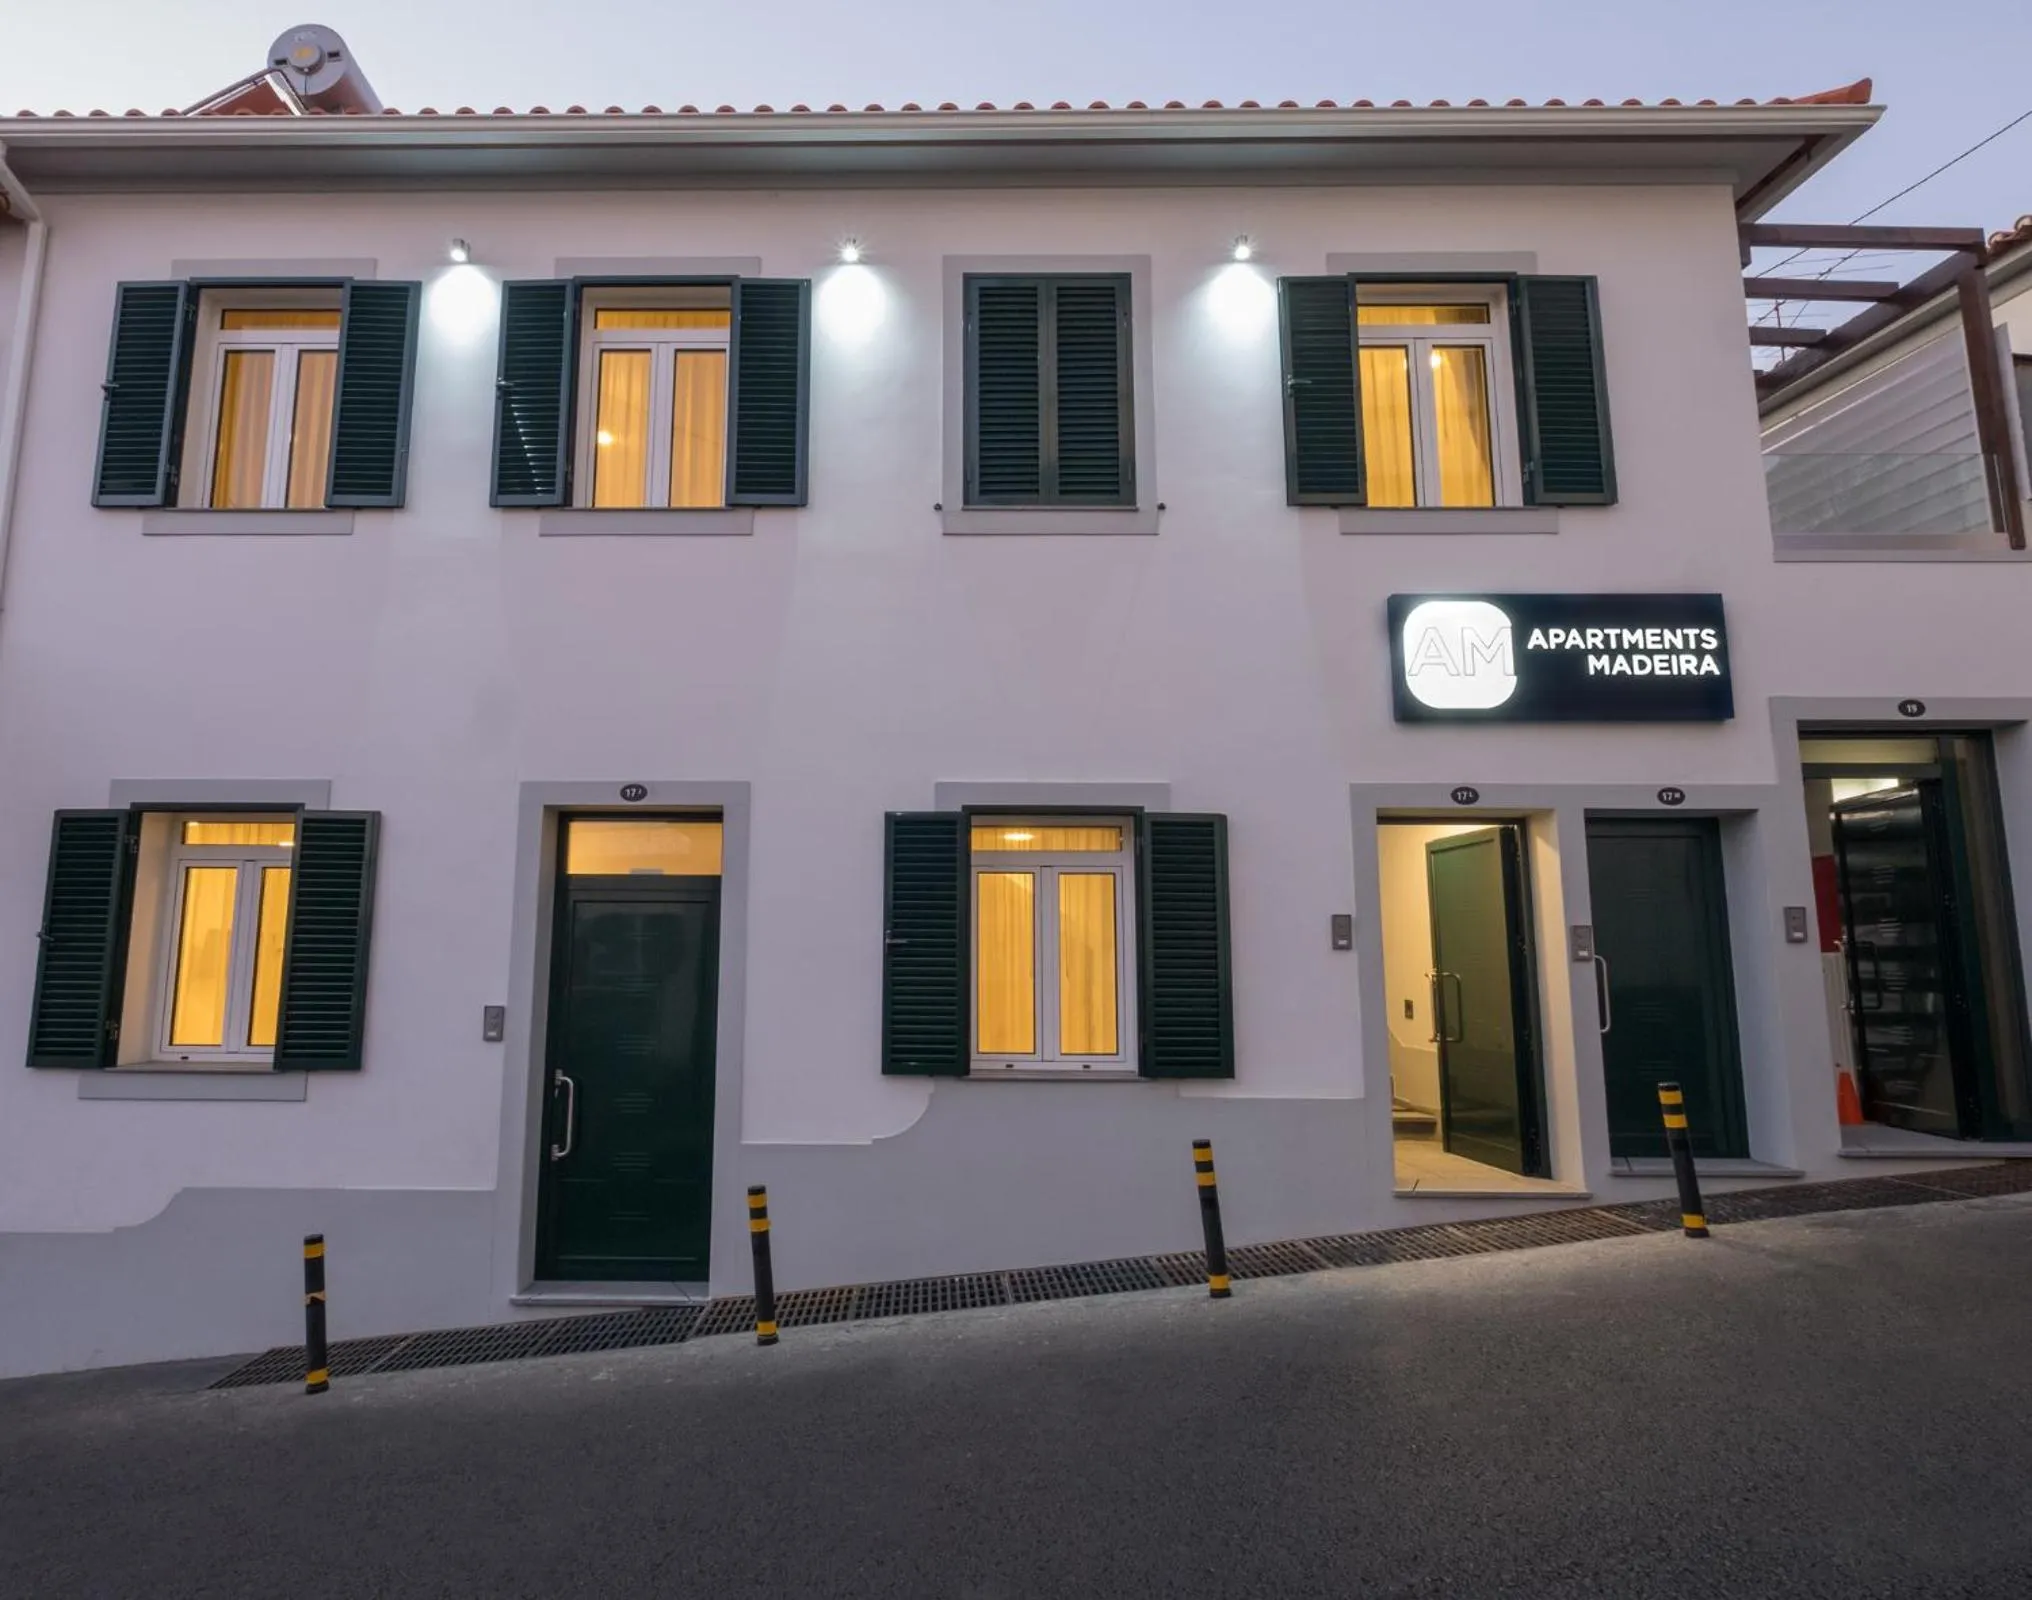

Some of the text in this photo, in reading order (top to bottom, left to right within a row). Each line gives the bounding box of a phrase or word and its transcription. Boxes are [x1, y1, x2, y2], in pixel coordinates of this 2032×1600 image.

[1526, 627, 1718, 650] APARTMENTS
[1408, 626, 1515, 677] AM
[1588, 653, 1722, 677] MADEIRA
